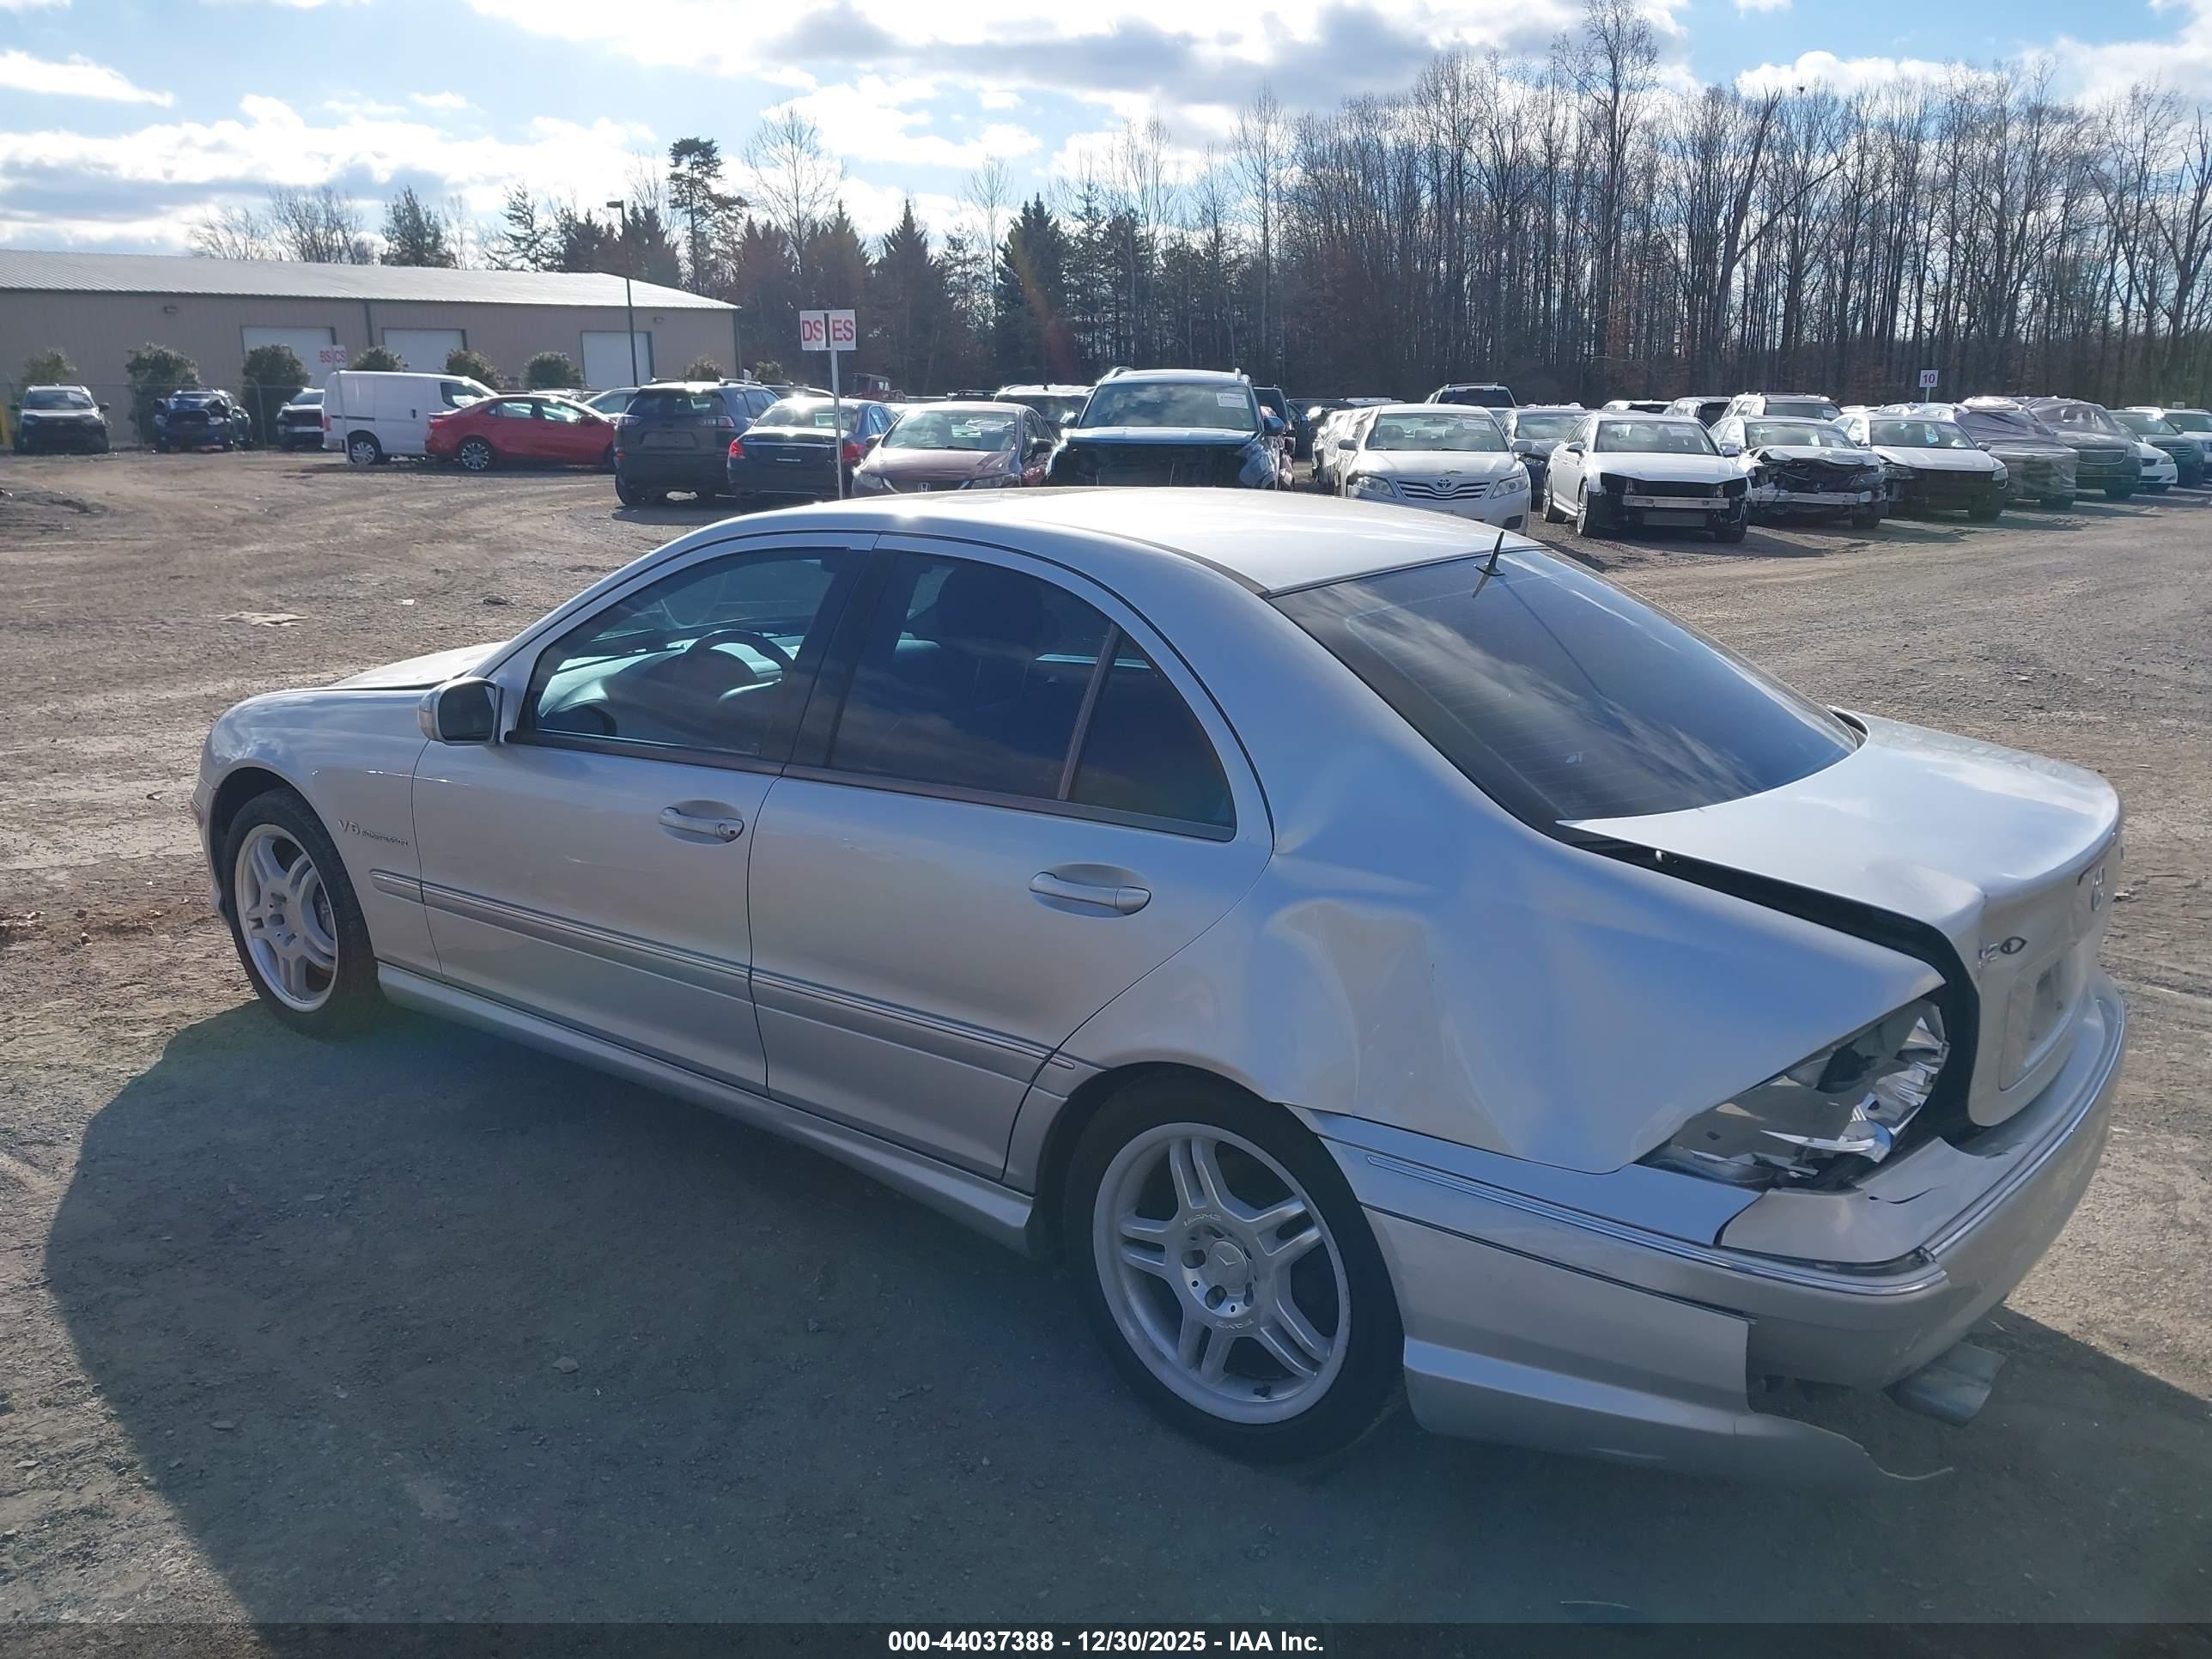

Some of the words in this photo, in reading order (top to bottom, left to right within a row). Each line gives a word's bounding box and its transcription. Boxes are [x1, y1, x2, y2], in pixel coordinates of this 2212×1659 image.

[801, 319, 824, 342] DS
[831, 319, 854, 342] ES
[1923, 374, 1936, 384] 10
